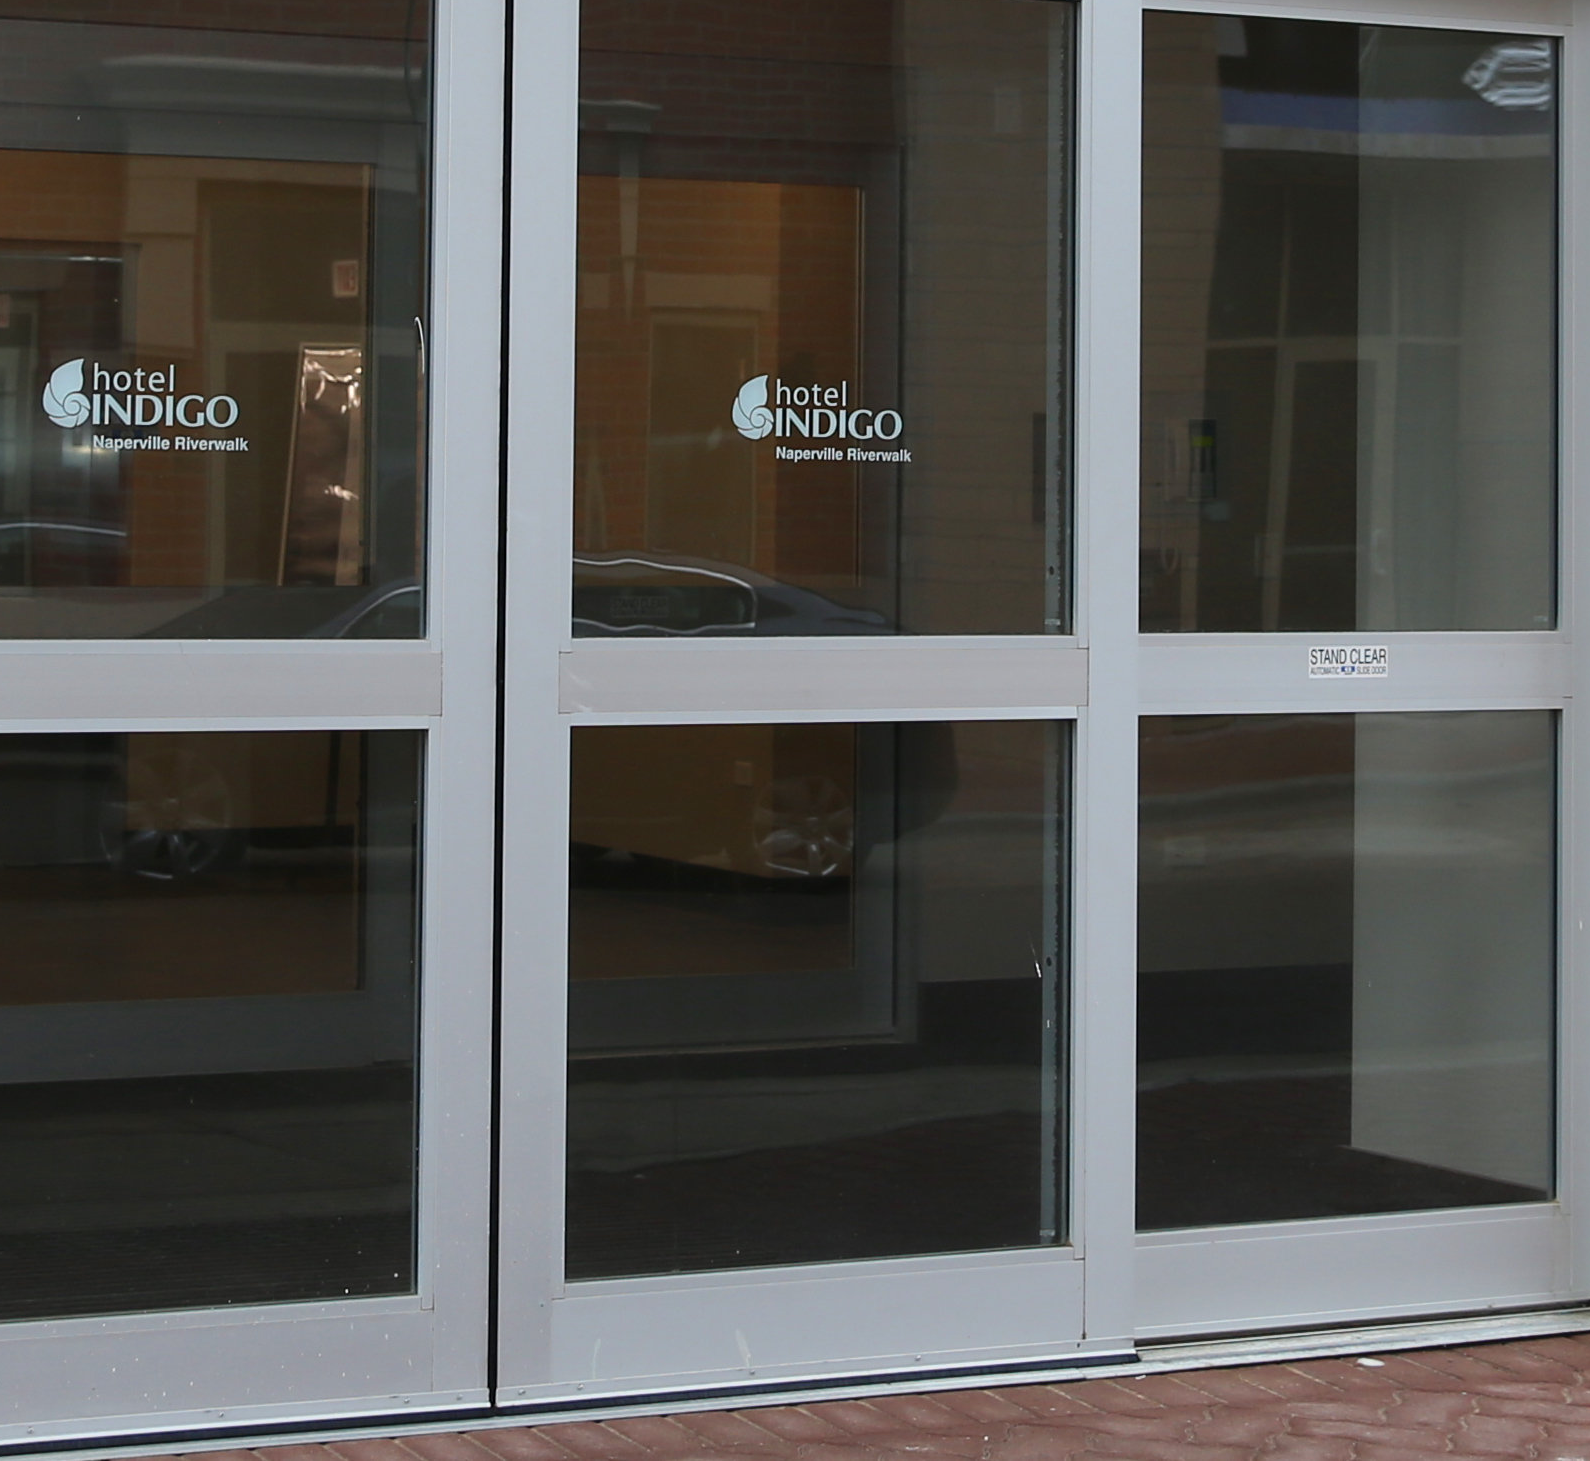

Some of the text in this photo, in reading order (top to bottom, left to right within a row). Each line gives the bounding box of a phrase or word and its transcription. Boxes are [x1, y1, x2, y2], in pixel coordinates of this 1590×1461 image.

[92, 362, 176, 393] hotel
[775, 378, 848, 407] hotel
[91, 393, 239, 428] INDIGO
[774, 407, 904, 440] INDIGO
[92, 434, 250, 452] Naperville Riverwalk
[775, 446, 912, 463] Naperville Riverwalk
[1310, 648, 1387, 665] STAND CLEAR
